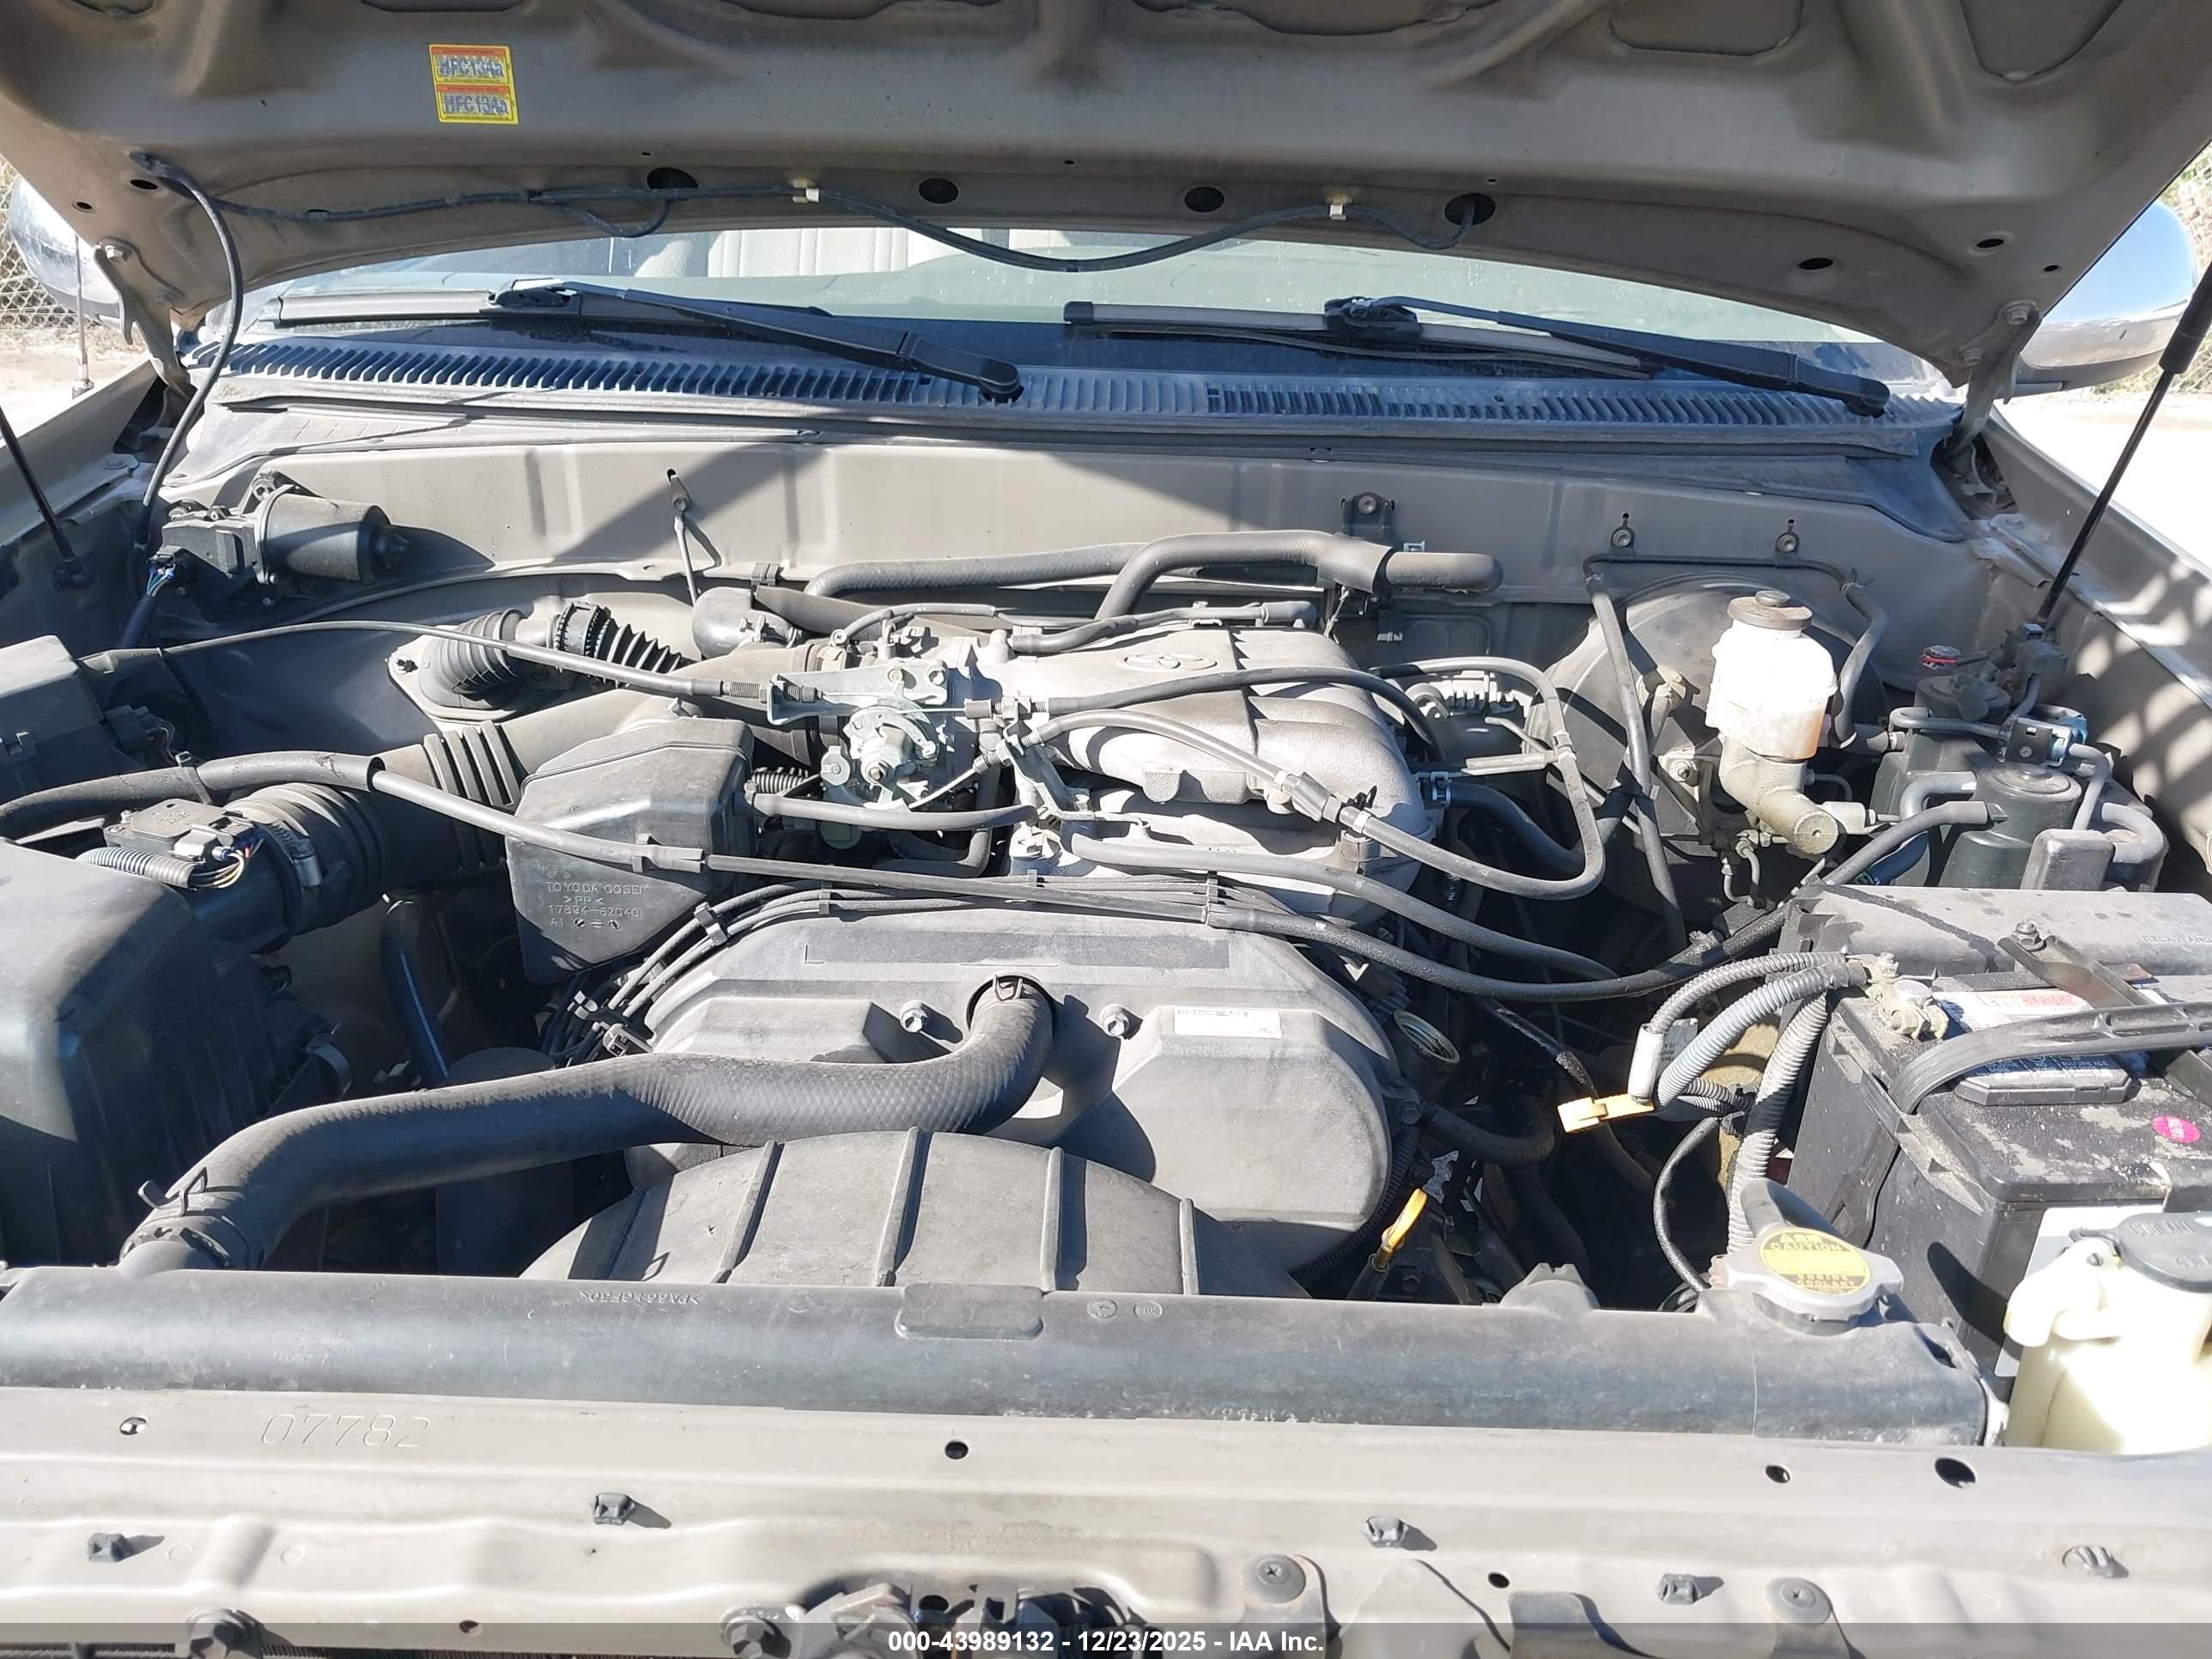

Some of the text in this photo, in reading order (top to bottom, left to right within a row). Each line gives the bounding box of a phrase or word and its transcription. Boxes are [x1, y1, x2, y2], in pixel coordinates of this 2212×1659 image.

[545, 881, 642, 895] TOYODA GOSEI
[1771, 1243, 1843, 1252] CAUTION
[261, 1413, 430, 1447] 07782
